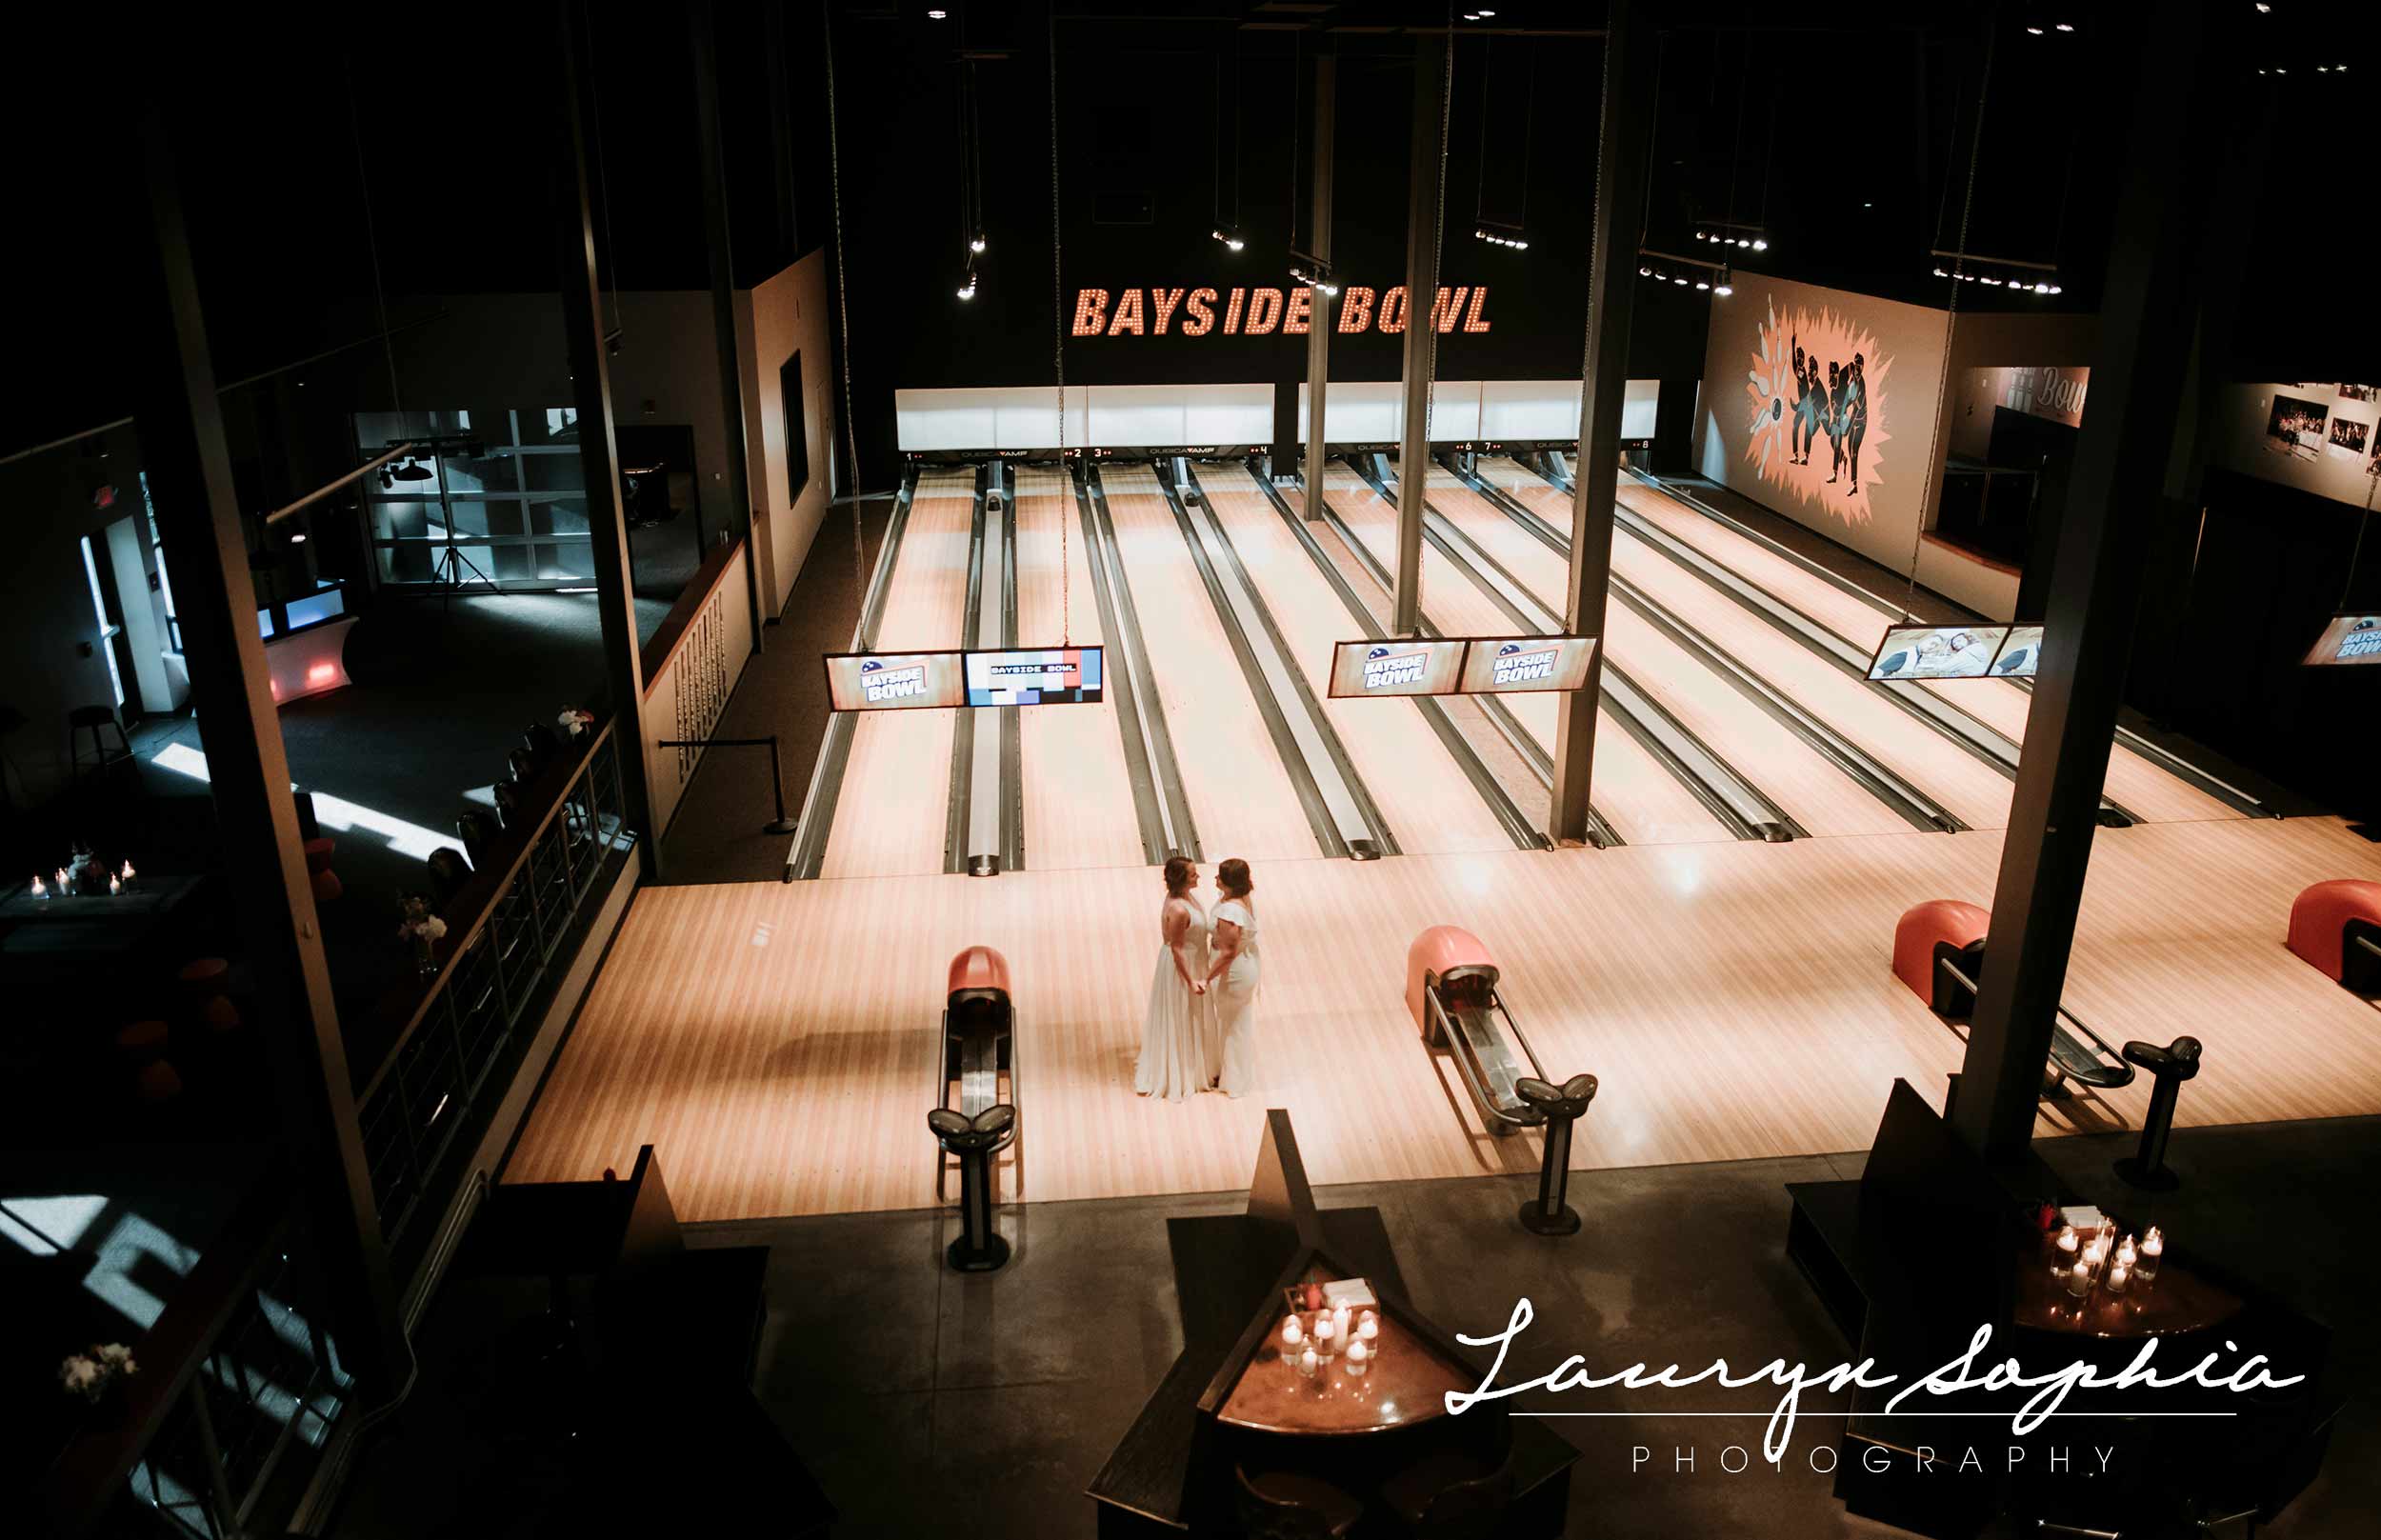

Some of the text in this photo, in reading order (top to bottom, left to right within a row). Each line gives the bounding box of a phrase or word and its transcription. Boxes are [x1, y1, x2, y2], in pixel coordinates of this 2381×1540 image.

[1070, 285, 1492, 336] BAYSIDE BOWL
[1465, 442, 1472, 450] 6
[1485, 442, 1491, 450] 7
[1642, 440, 1650, 449] 8
[1073, 449, 1082, 457] 2
[1093, 449, 1102, 457] 3
[1260, 446, 1268, 454] 4
[1364, 657, 1425, 674] BAYSIDE
[1492, 652, 1554, 671] BAYSIDE
[990, 664, 1076, 674] BAYSIDE BOWL
[1365, 668, 1424, 689] BOWL
[1493, 664, 1554, 685] BOWL
[868, 680, 927, 702] BOWL
